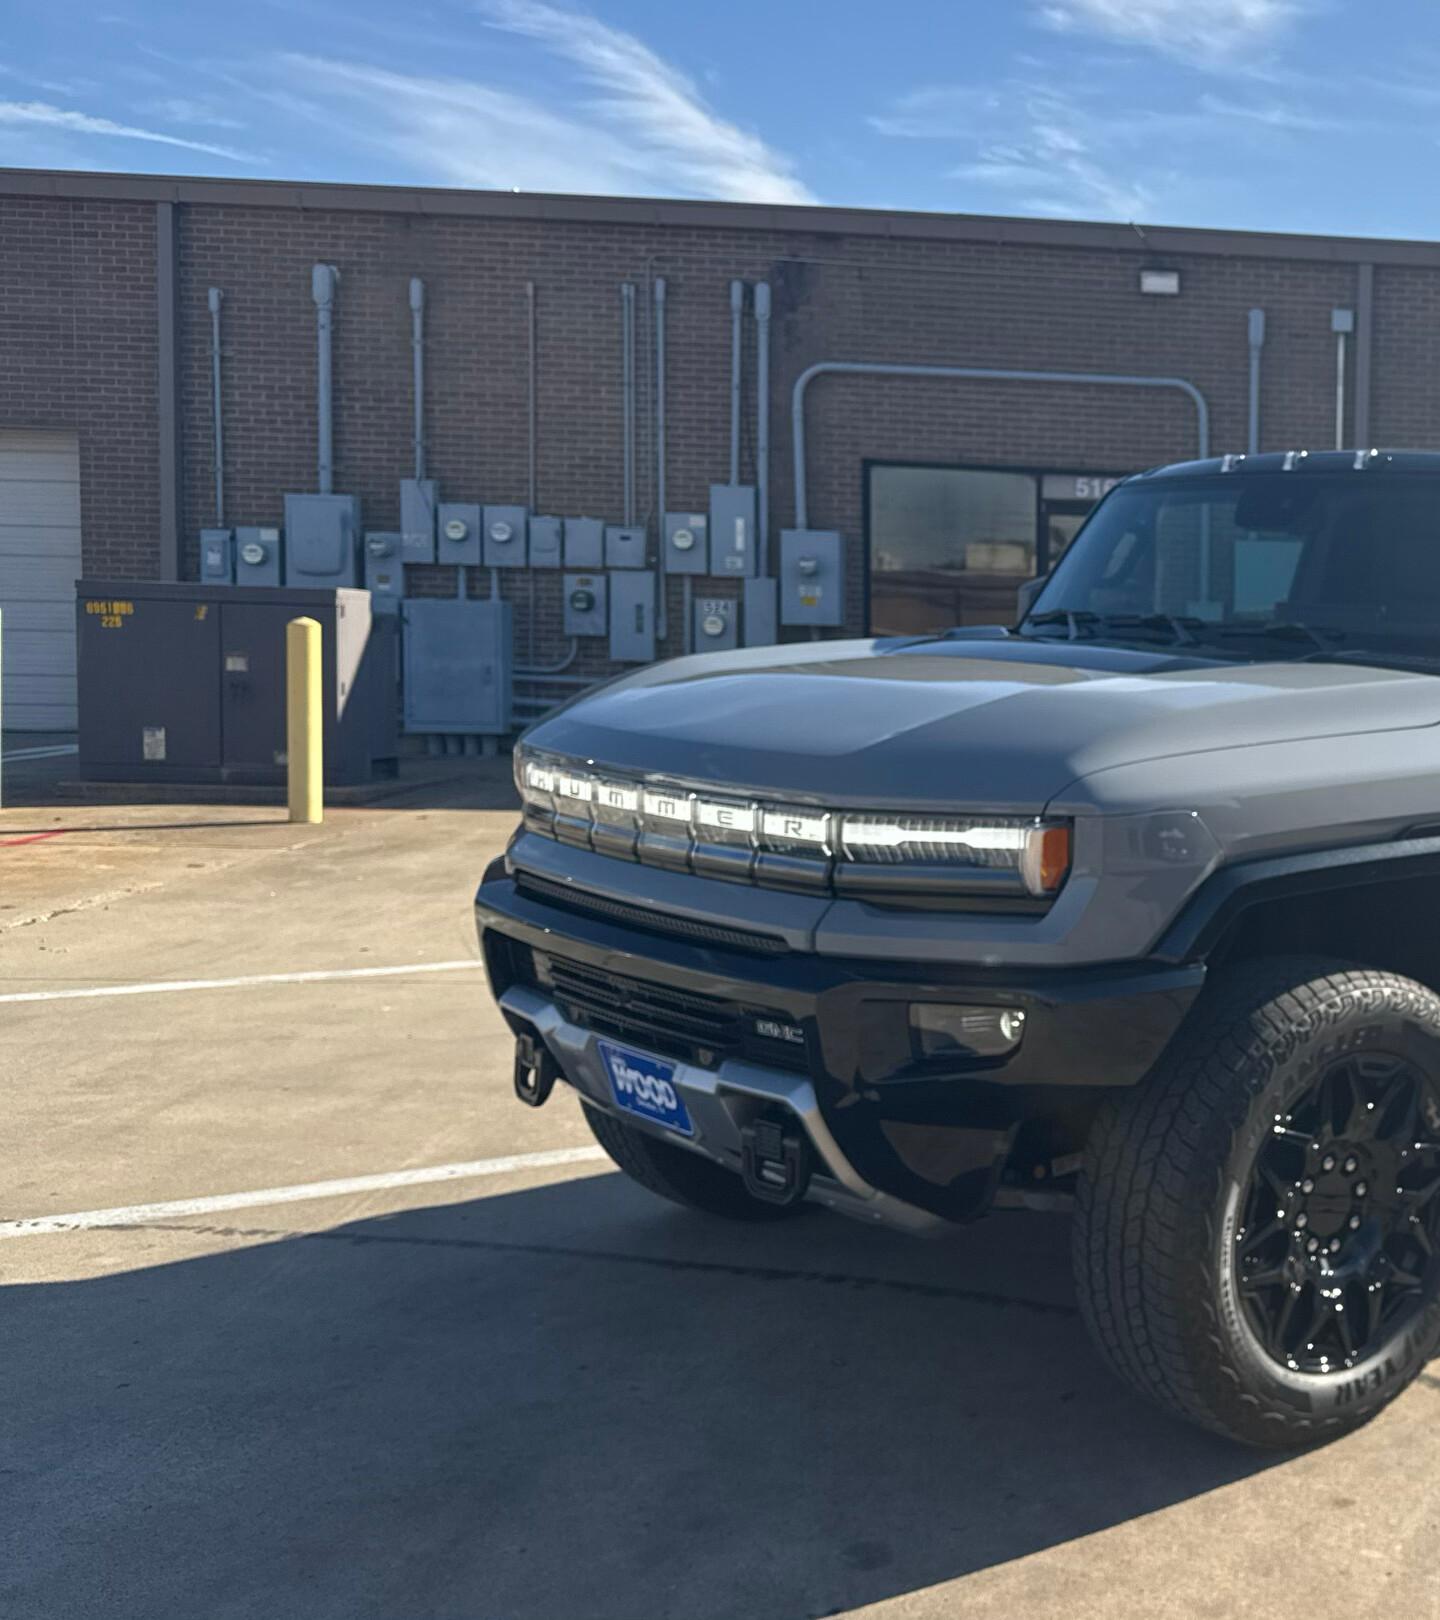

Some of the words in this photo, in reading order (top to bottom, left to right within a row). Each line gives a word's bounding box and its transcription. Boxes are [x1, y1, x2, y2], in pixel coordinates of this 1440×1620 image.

[536, 773, 803, 836] HUMMER
[756, 1020, 804, 1044] GMC
[610, 1055, 677, 1110] WOOD
